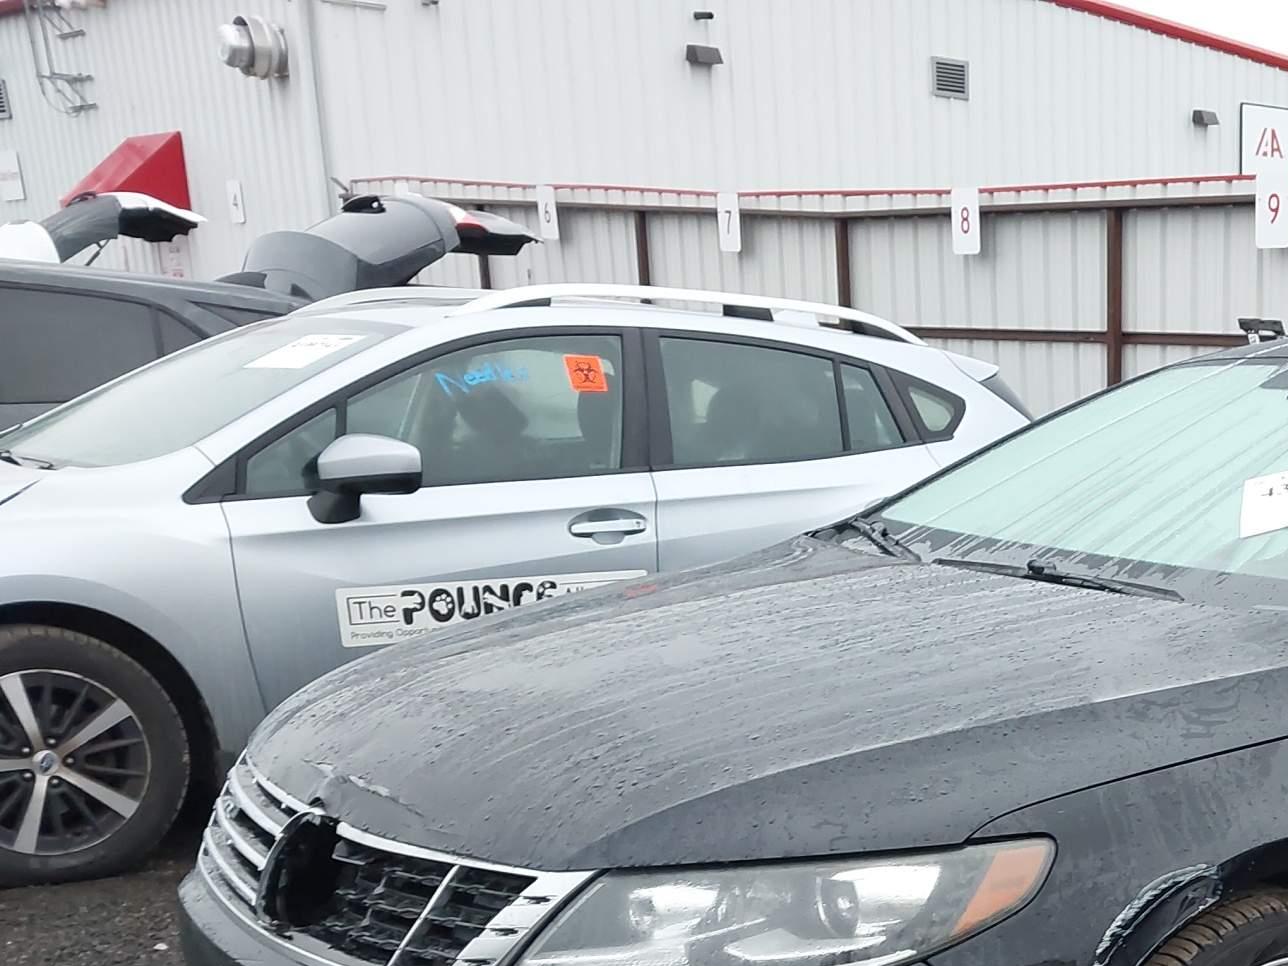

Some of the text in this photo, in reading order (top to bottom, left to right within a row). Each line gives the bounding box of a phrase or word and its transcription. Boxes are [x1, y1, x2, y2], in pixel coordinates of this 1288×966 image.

[544, 203, 551, 224] 6
[1268, 193, 1280, 224] 9
[724, 210, 732, 235] 7
[960, 206, 970, 235] 8
[352, 600, 396, 620] The
[351, 629, 394, 640] Providing
